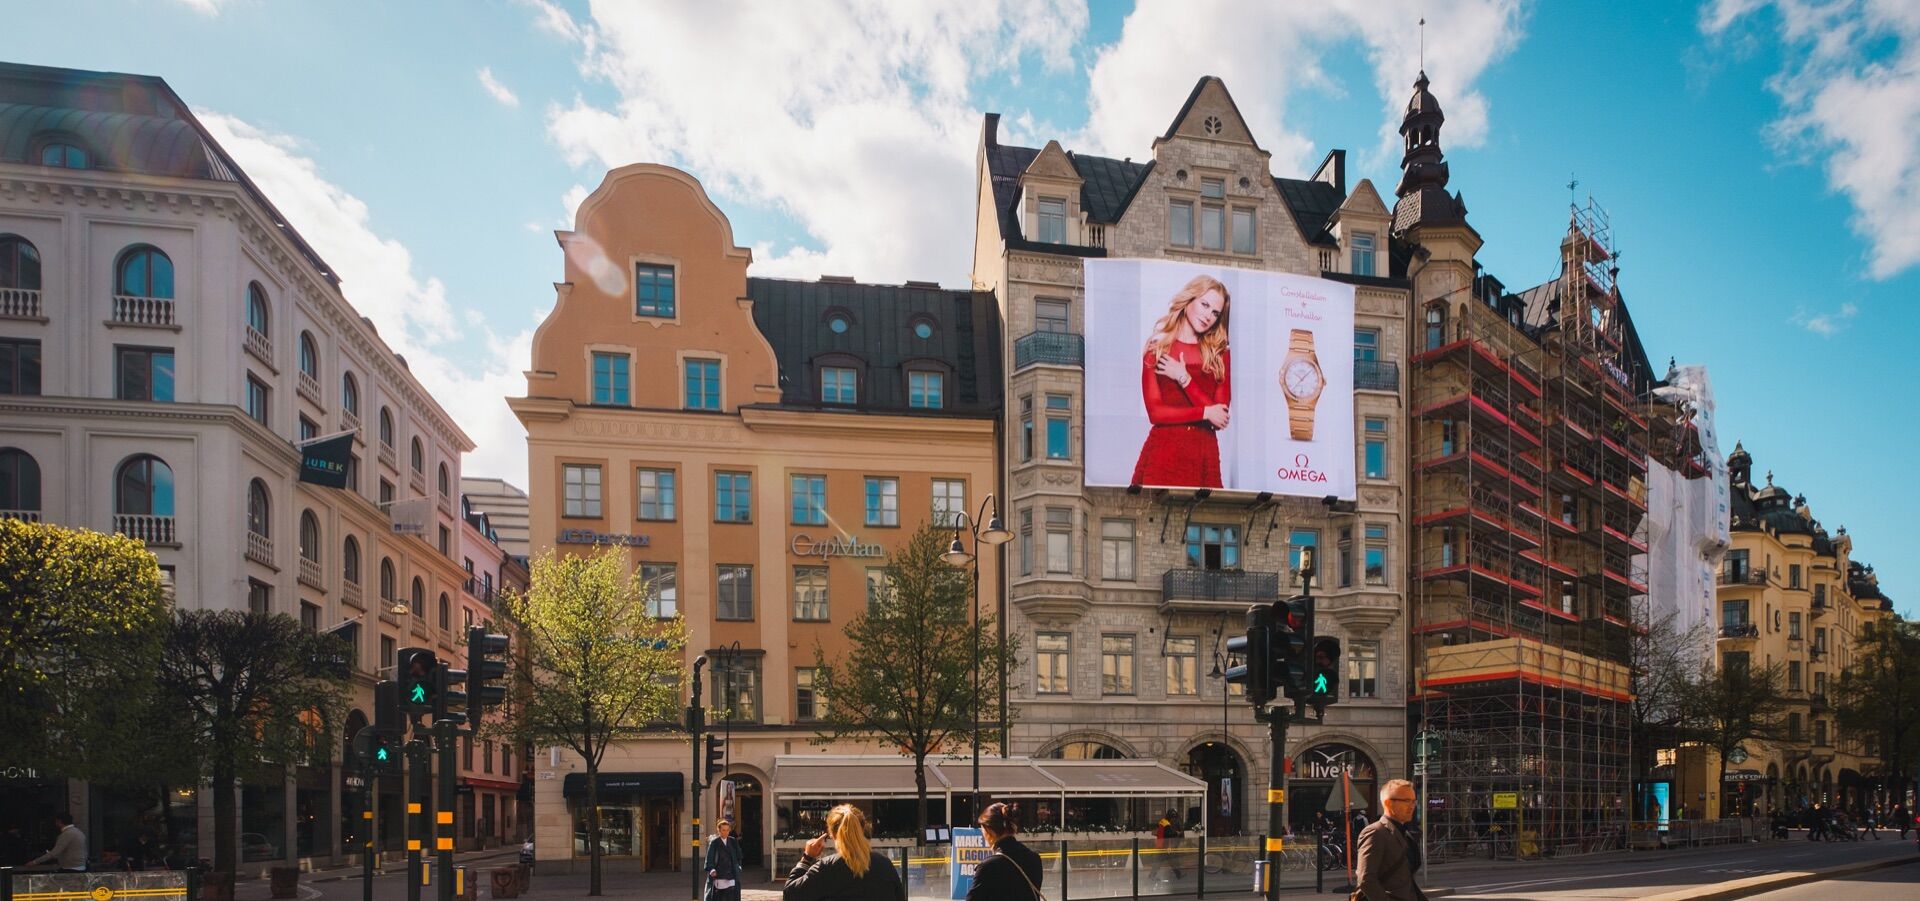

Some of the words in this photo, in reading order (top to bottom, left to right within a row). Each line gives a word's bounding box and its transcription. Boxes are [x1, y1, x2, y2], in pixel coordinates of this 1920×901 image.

[305, 457, 344, 472] JUREK
[1278, 468, 1327, 482] OMEGA
[791, 531, 884, 561] CapMan
[955, 835, 983, 847] MAKE
